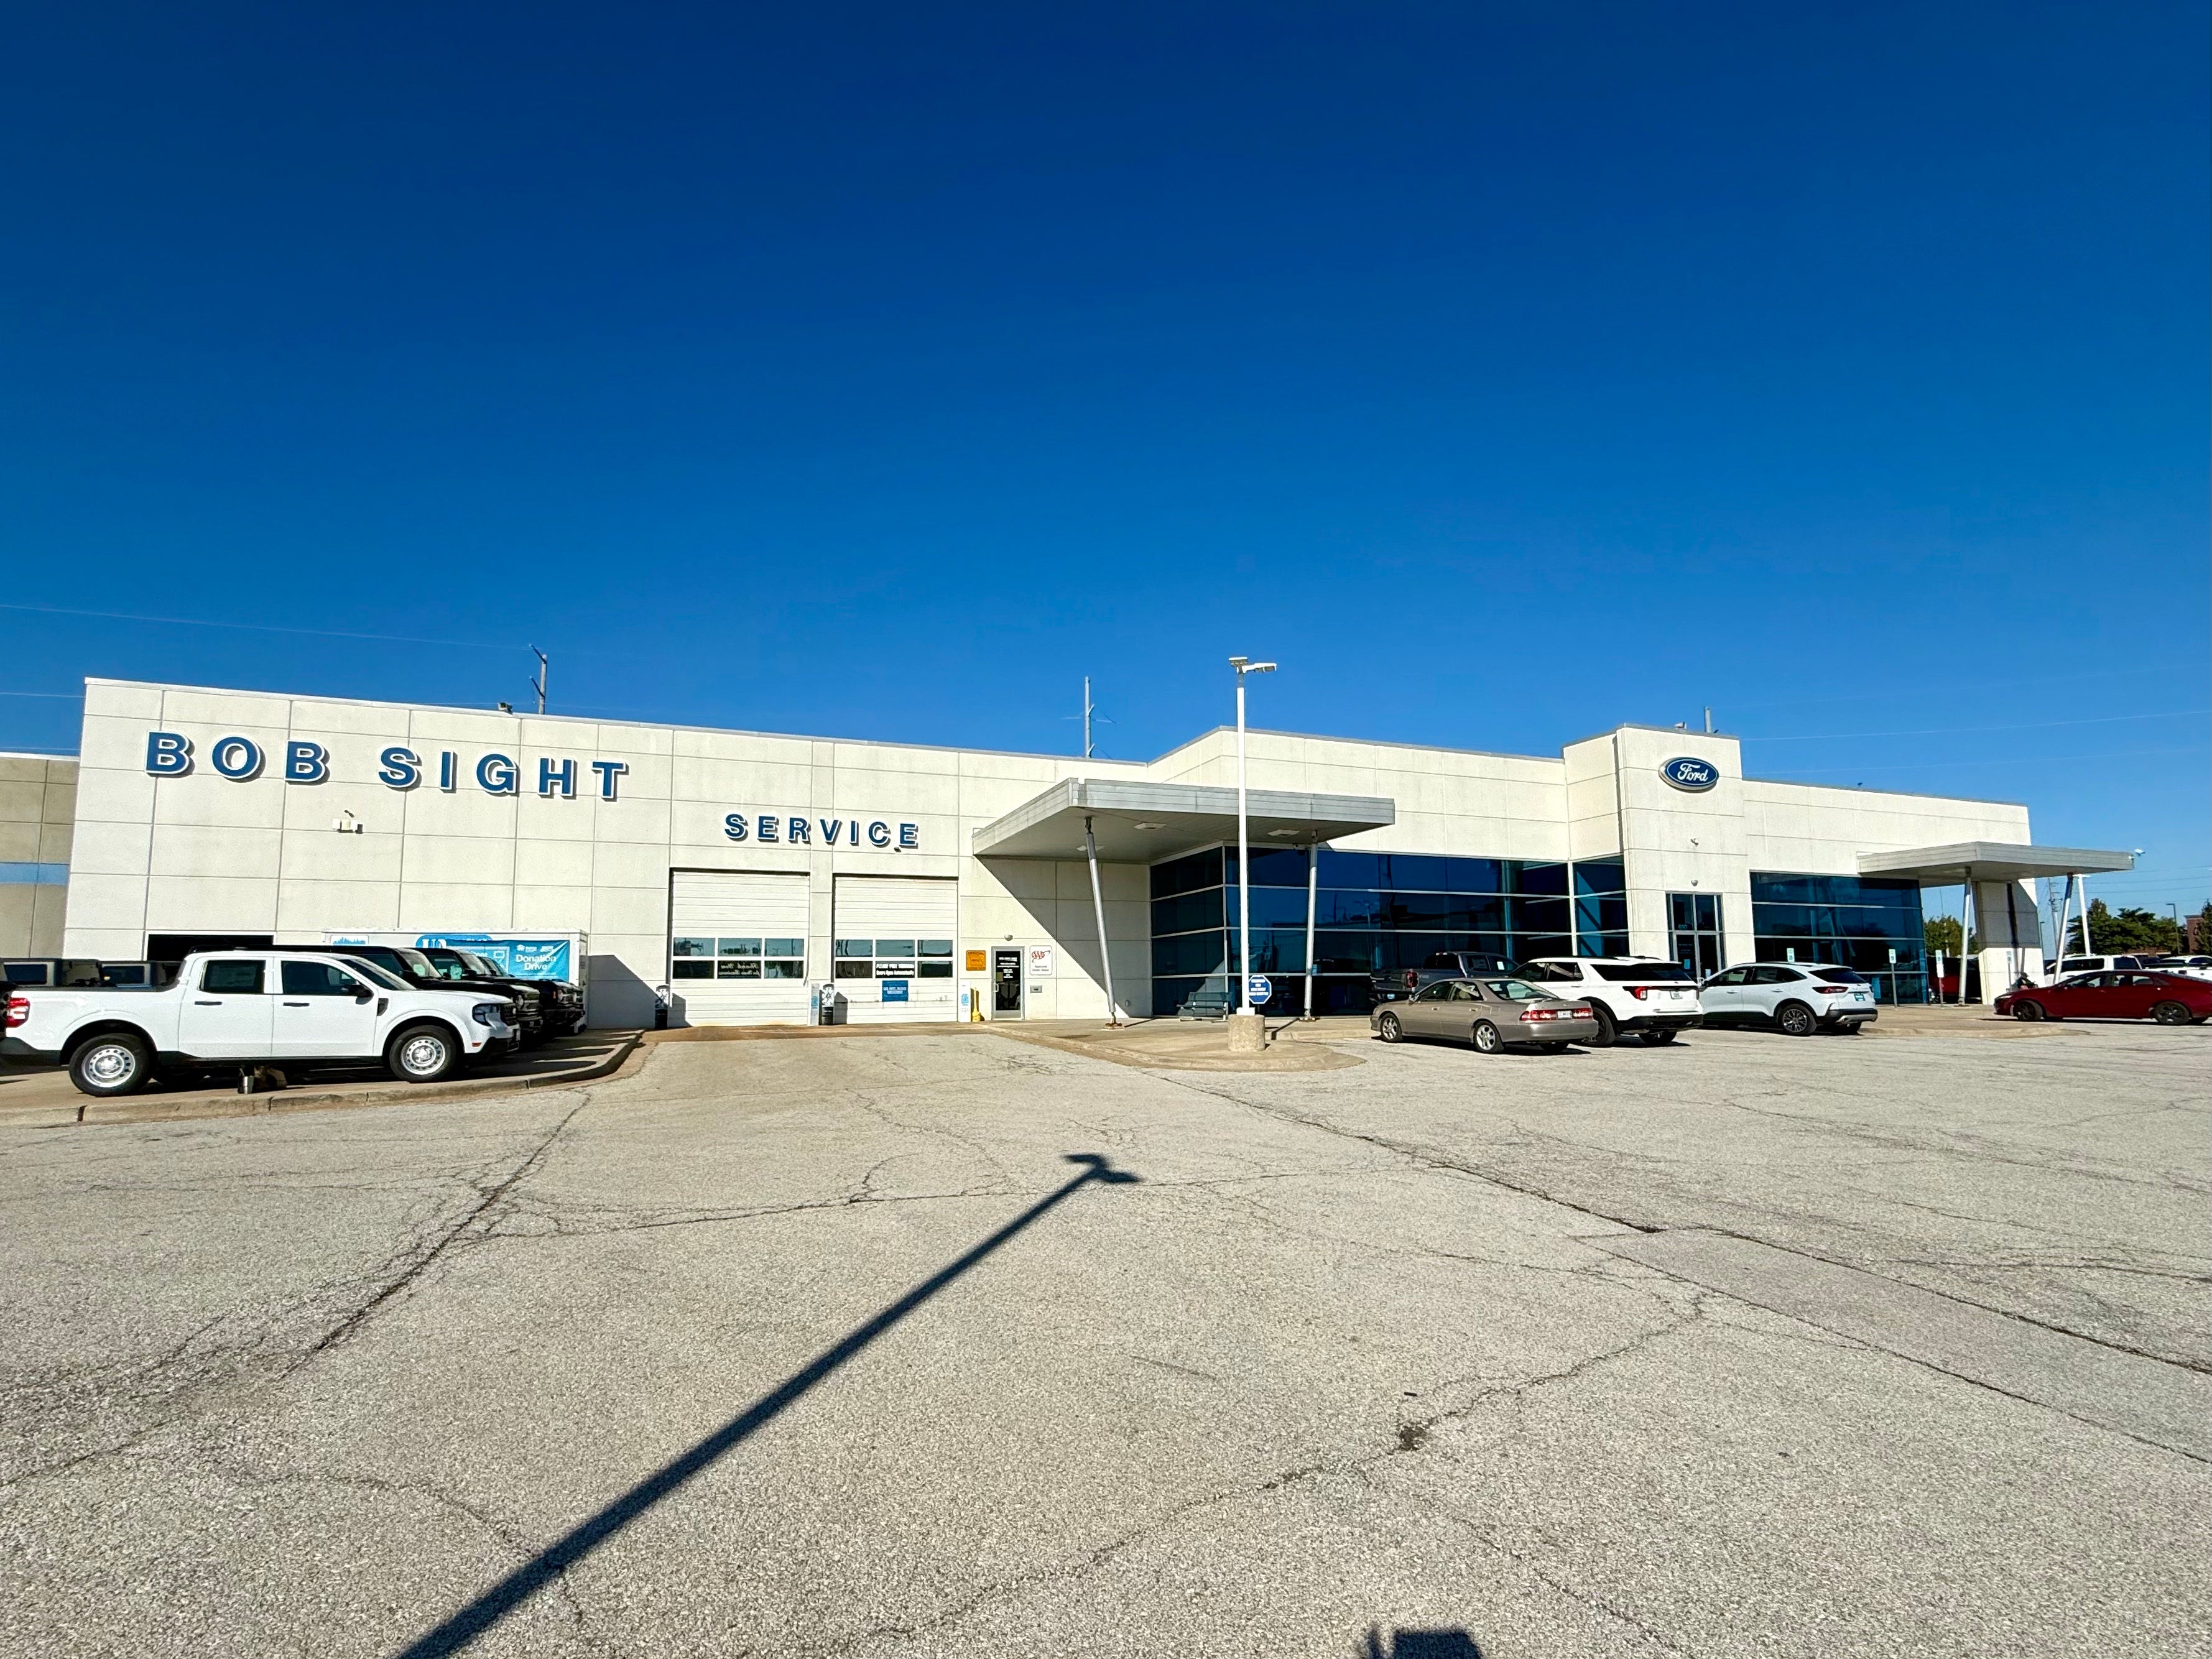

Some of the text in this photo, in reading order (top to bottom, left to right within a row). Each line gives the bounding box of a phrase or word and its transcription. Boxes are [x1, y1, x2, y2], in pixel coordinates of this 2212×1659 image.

[145, 730, 628, 800] BOB SIGHT
[1677, 762, 1709, 782] Ford
[723, 813, 919, 848] SERVICE
[516, 954, 557, 963] Donation
[524, 962, 548, 971] Drive
